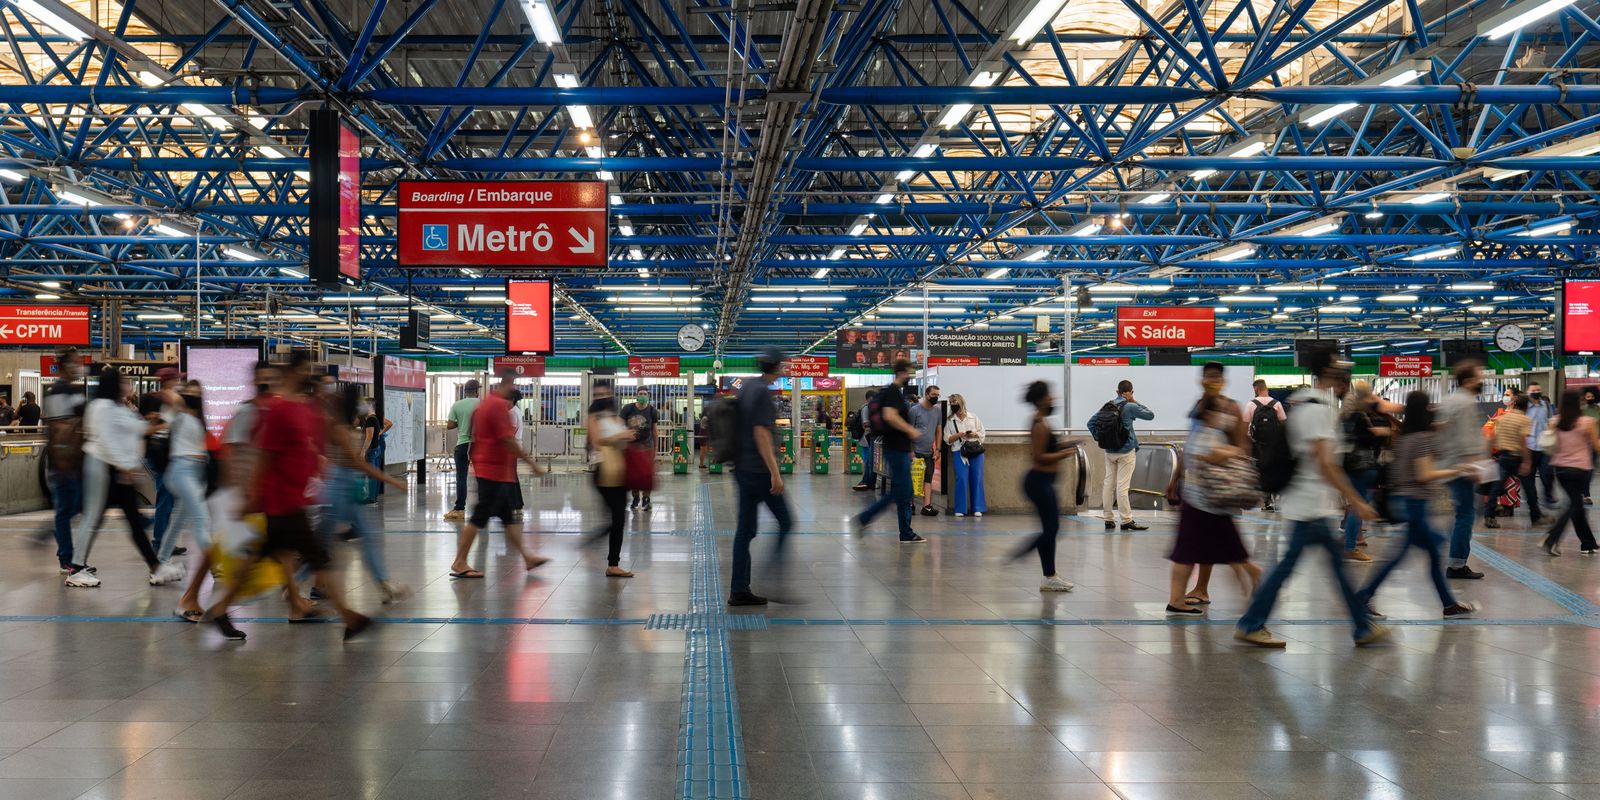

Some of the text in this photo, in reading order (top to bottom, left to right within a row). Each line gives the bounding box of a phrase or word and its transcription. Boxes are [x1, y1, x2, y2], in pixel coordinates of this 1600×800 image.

[411, 189, 553, 204] Boarding / Embarque
[458, 223, 553, 252] Metrô
[16, 308, 62, 316] Transferência
[16, 324, 62, 338] CPTM
[1141, 325, 1186, 339] Saída
[119, 366, 149, 375] CPTM
